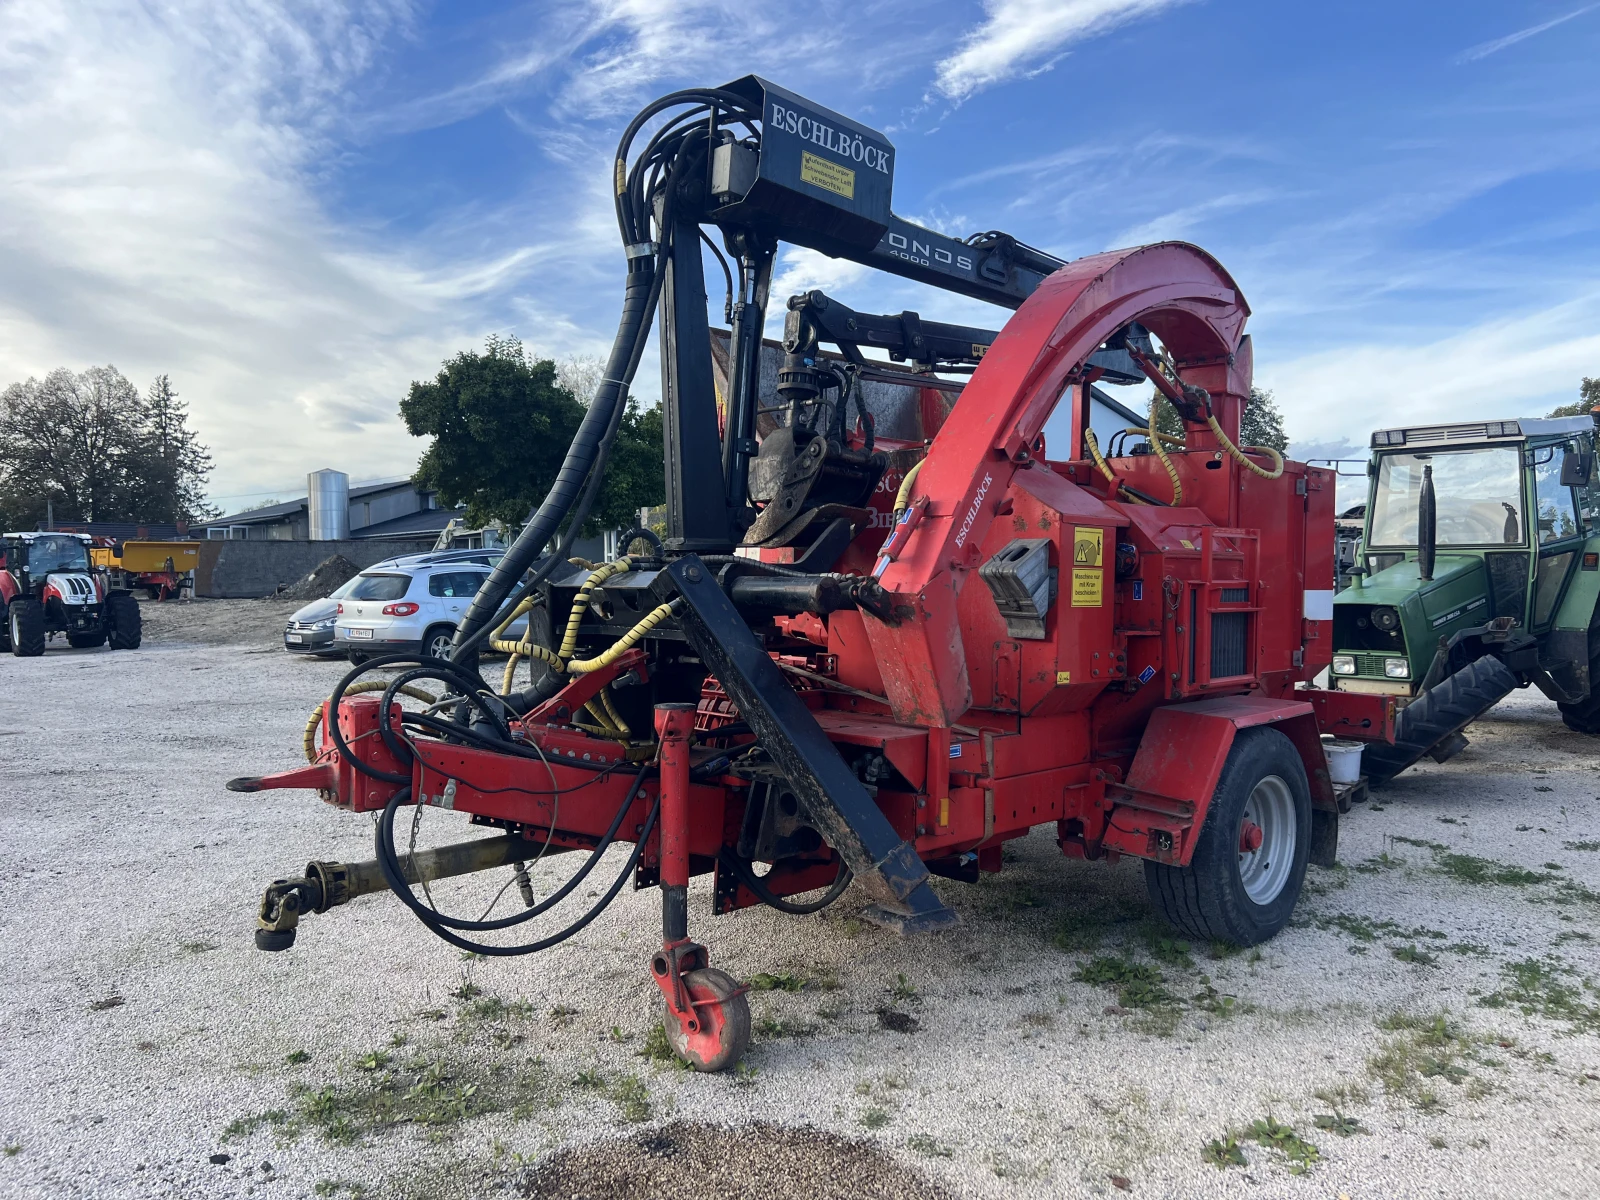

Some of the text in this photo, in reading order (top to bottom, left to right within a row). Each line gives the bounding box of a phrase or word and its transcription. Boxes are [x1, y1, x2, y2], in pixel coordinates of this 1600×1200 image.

[770, 103, 890, 175] ESCHLBÖCK
[807, 156, 835, 171] Aufenthalt
[880, 232, 972, 271] ONOS
[889, 250, 930, 267] 4000
[954, 472, 993, 549] ESCHLBÖCK
